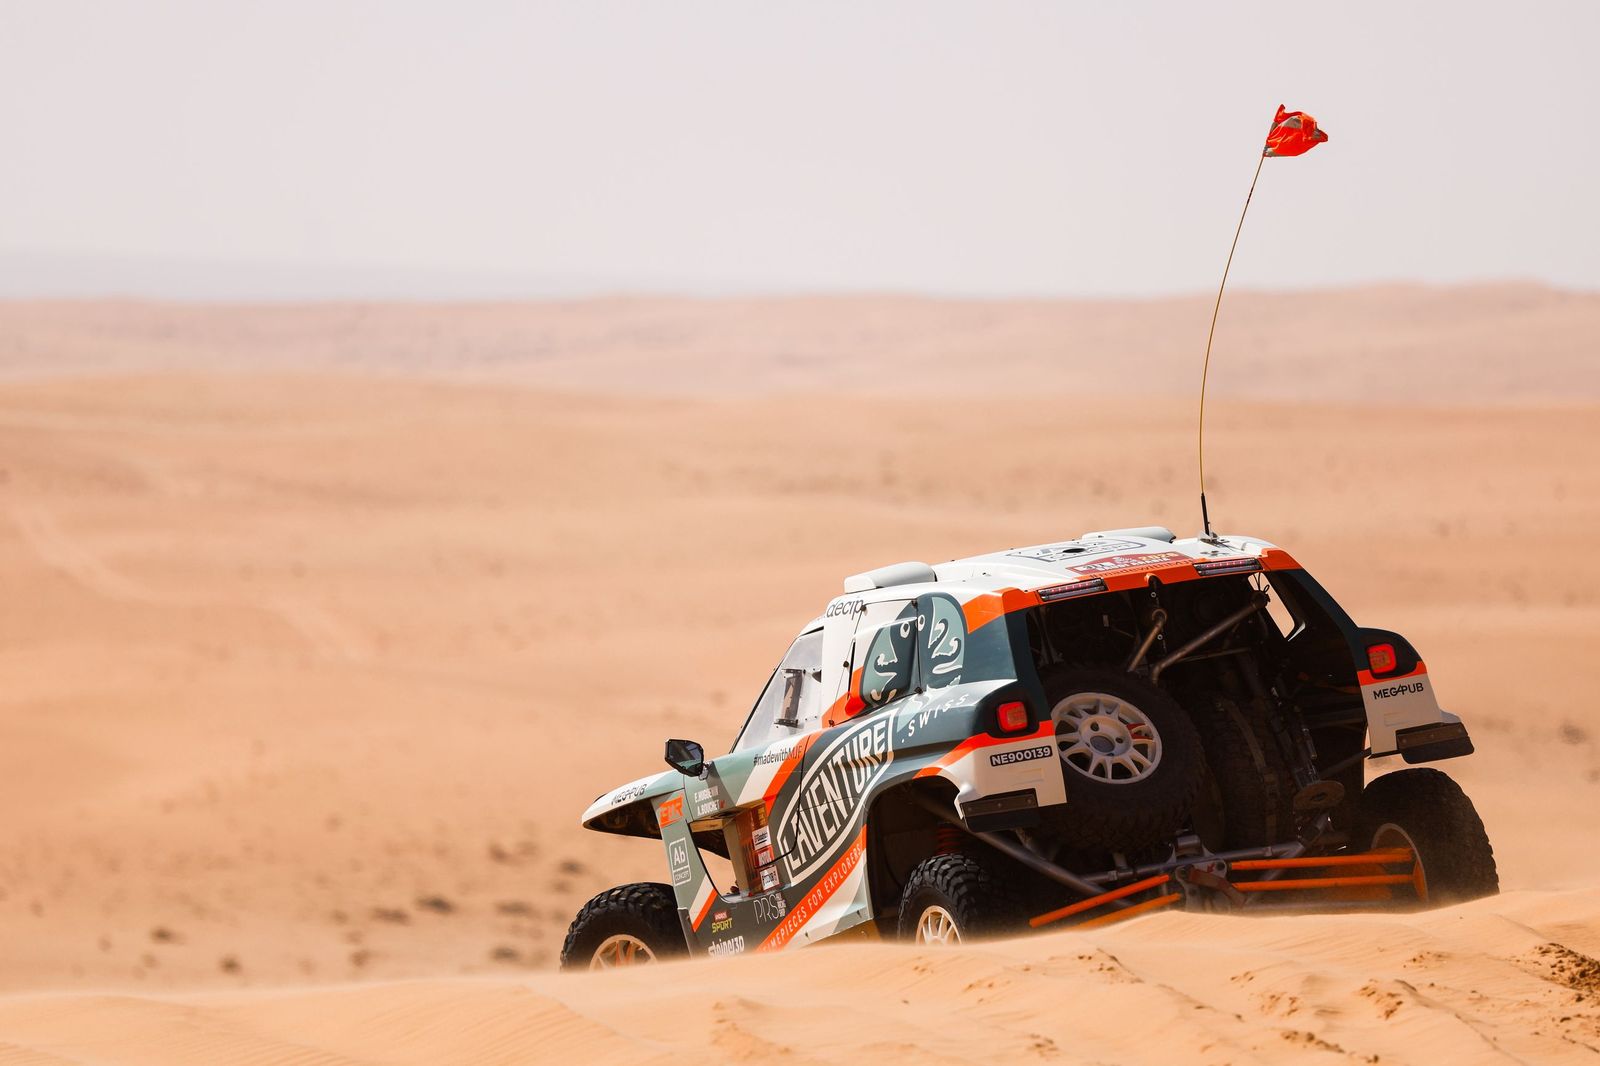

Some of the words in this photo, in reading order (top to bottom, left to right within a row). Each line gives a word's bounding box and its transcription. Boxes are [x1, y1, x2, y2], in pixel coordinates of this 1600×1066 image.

[991, 746, 1051, 766] NE900139
[783, 719, 887, 871] LAVENTURE
[673, 845, 686, 866] Ab
[808, 888, 825, 912] FOR
[823, 843, 862, 894] EXPLORERS
[753, 894, 780, 925] PRS
[711, 917, 733, 934] SPORT
